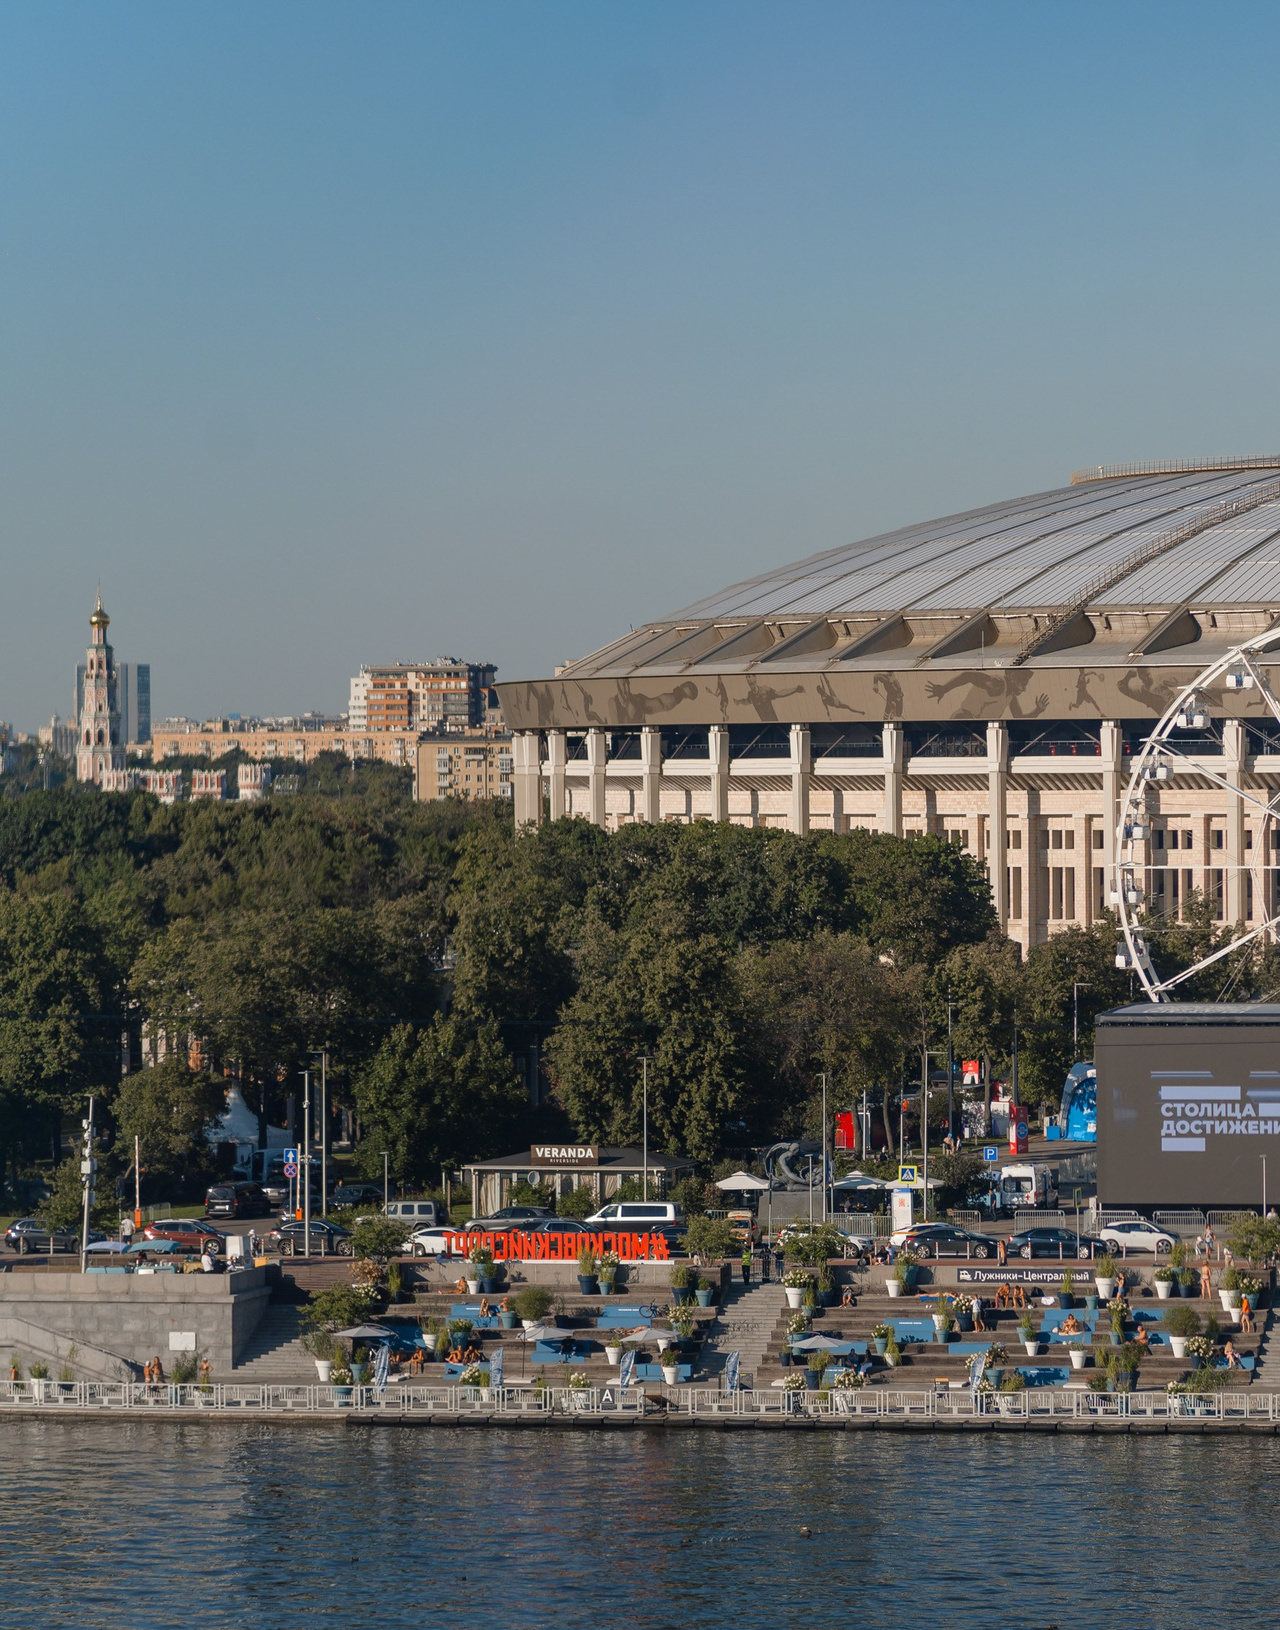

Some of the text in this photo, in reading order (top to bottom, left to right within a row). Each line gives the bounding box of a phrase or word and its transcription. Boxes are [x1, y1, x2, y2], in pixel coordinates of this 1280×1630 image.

[1160, 1103, 1256, 1119] СТОЛИЦА
[535, 1147, 594, 1158] VERANDA
[987, 1149, 995, 1159] P
[602, 1389, 613, 1402] A
